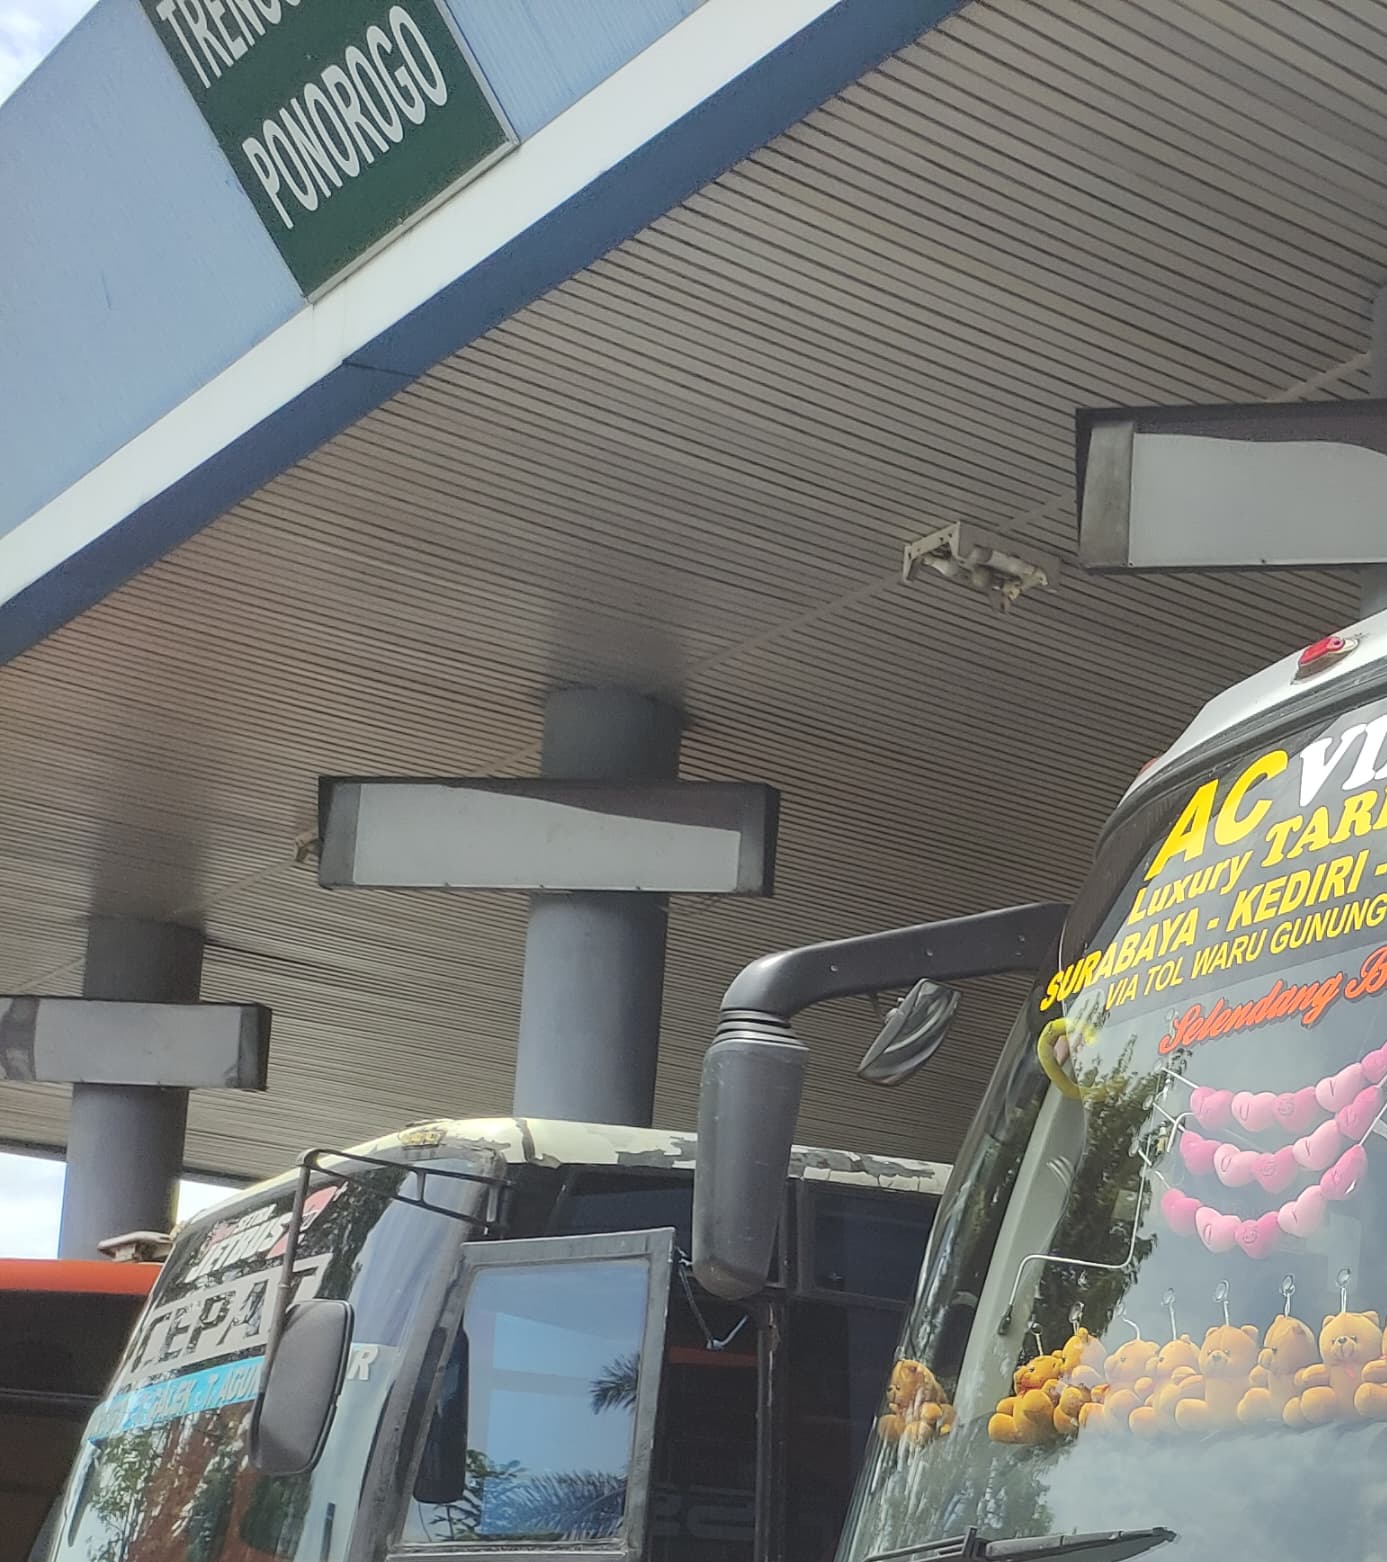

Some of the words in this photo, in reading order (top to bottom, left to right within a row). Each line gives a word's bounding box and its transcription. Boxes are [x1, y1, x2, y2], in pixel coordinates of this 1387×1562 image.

[242, 5, 447, 229] PONOROGO
[1143, 749, 1289, 882] AC
[1039, 908, 1200, 1012] SURABAYA
[1225, 850, 1370, 932] KEDIRI
[1126, 850, 1254, 926] Luxury
[1104, 974, 1140, 1012] VIA
[1143, 957, 1185, 996] TOL
[1191, 929, 1268, 979] WARU
[1158, 972, 1344, 1056] Selendang
